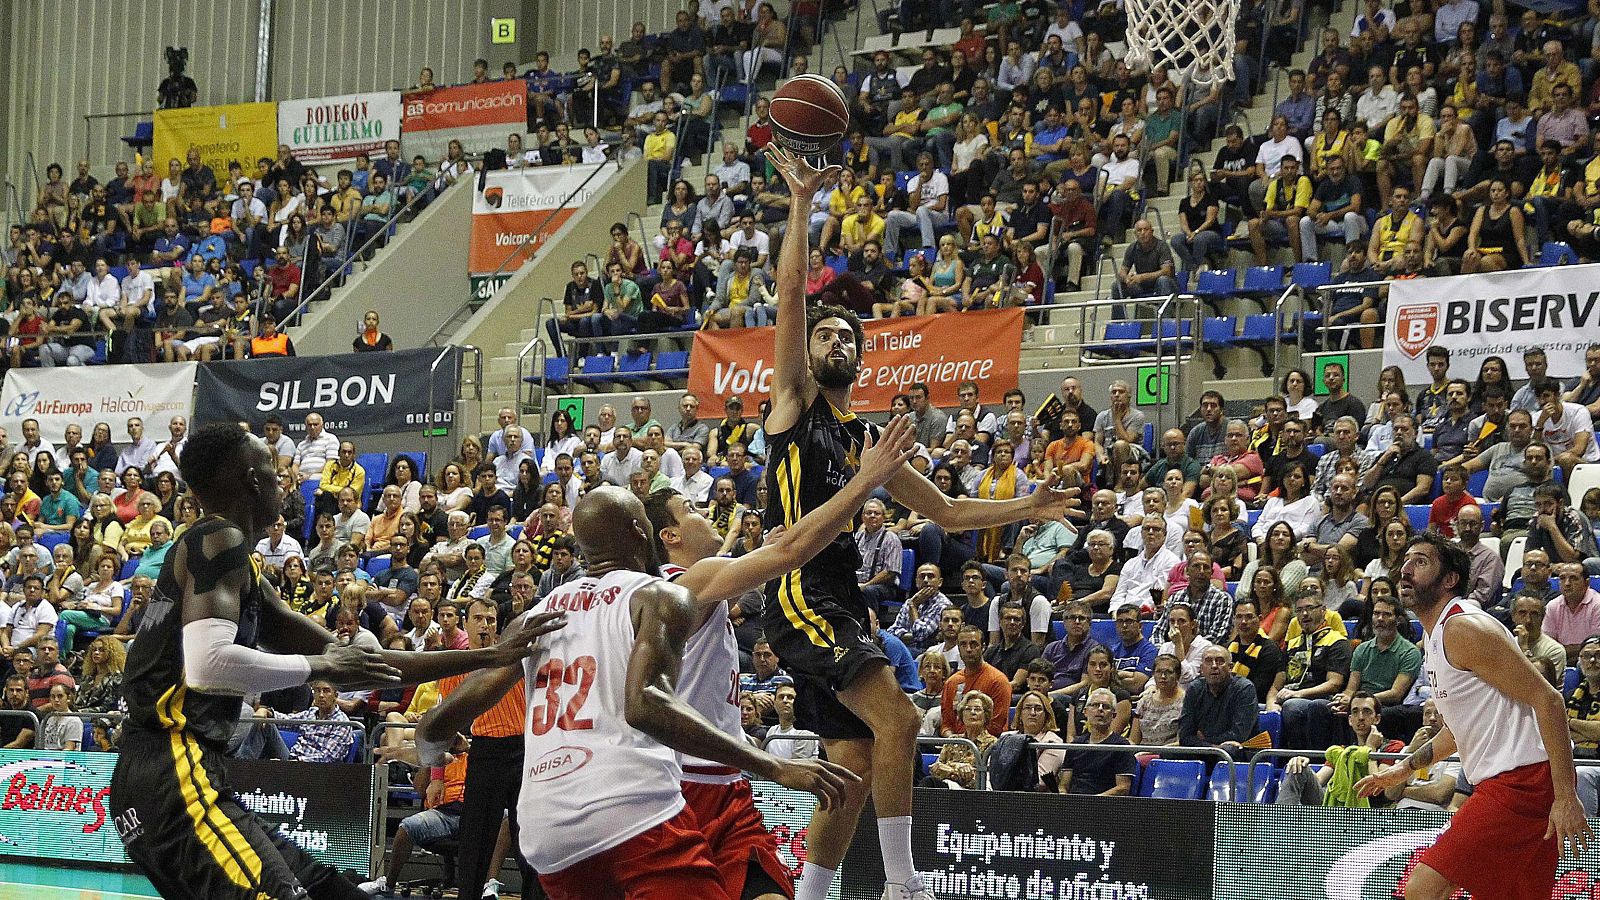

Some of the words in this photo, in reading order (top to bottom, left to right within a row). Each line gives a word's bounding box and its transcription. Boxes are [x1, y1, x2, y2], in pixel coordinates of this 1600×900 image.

[499, 24, 509, 37] B
[306, 96, 368, 125] BODEGÓN
[425, 92, 523, 115] comunicación
[293, 119, 383, 145] GUILLERMO
[1443, 290, 1600, 335] BISERV
[881, 329, 923, 351] Teide
[1407, 319, 1427, 342] B
[1458, 343, 1513, 358] seguridad
[713, 358, 776, 395] Volc
[876, 355, 994, 392] experience
[32, 399, 93, 417] AirEuropa
[255, 373, 397, 412] SILBON
[531, 655, 597, 736] 32
[2, 771, 112, 834] Balmes
[233, 787, 296, 815] miento
[296, 797, 308, 822] y
[936, 819, 1097, 865] Equipamiento
[1099, 840, 1116, 871] y
[1026, 869, 1055, 900] de
[1059, 872, 1149, 900] oficinas
